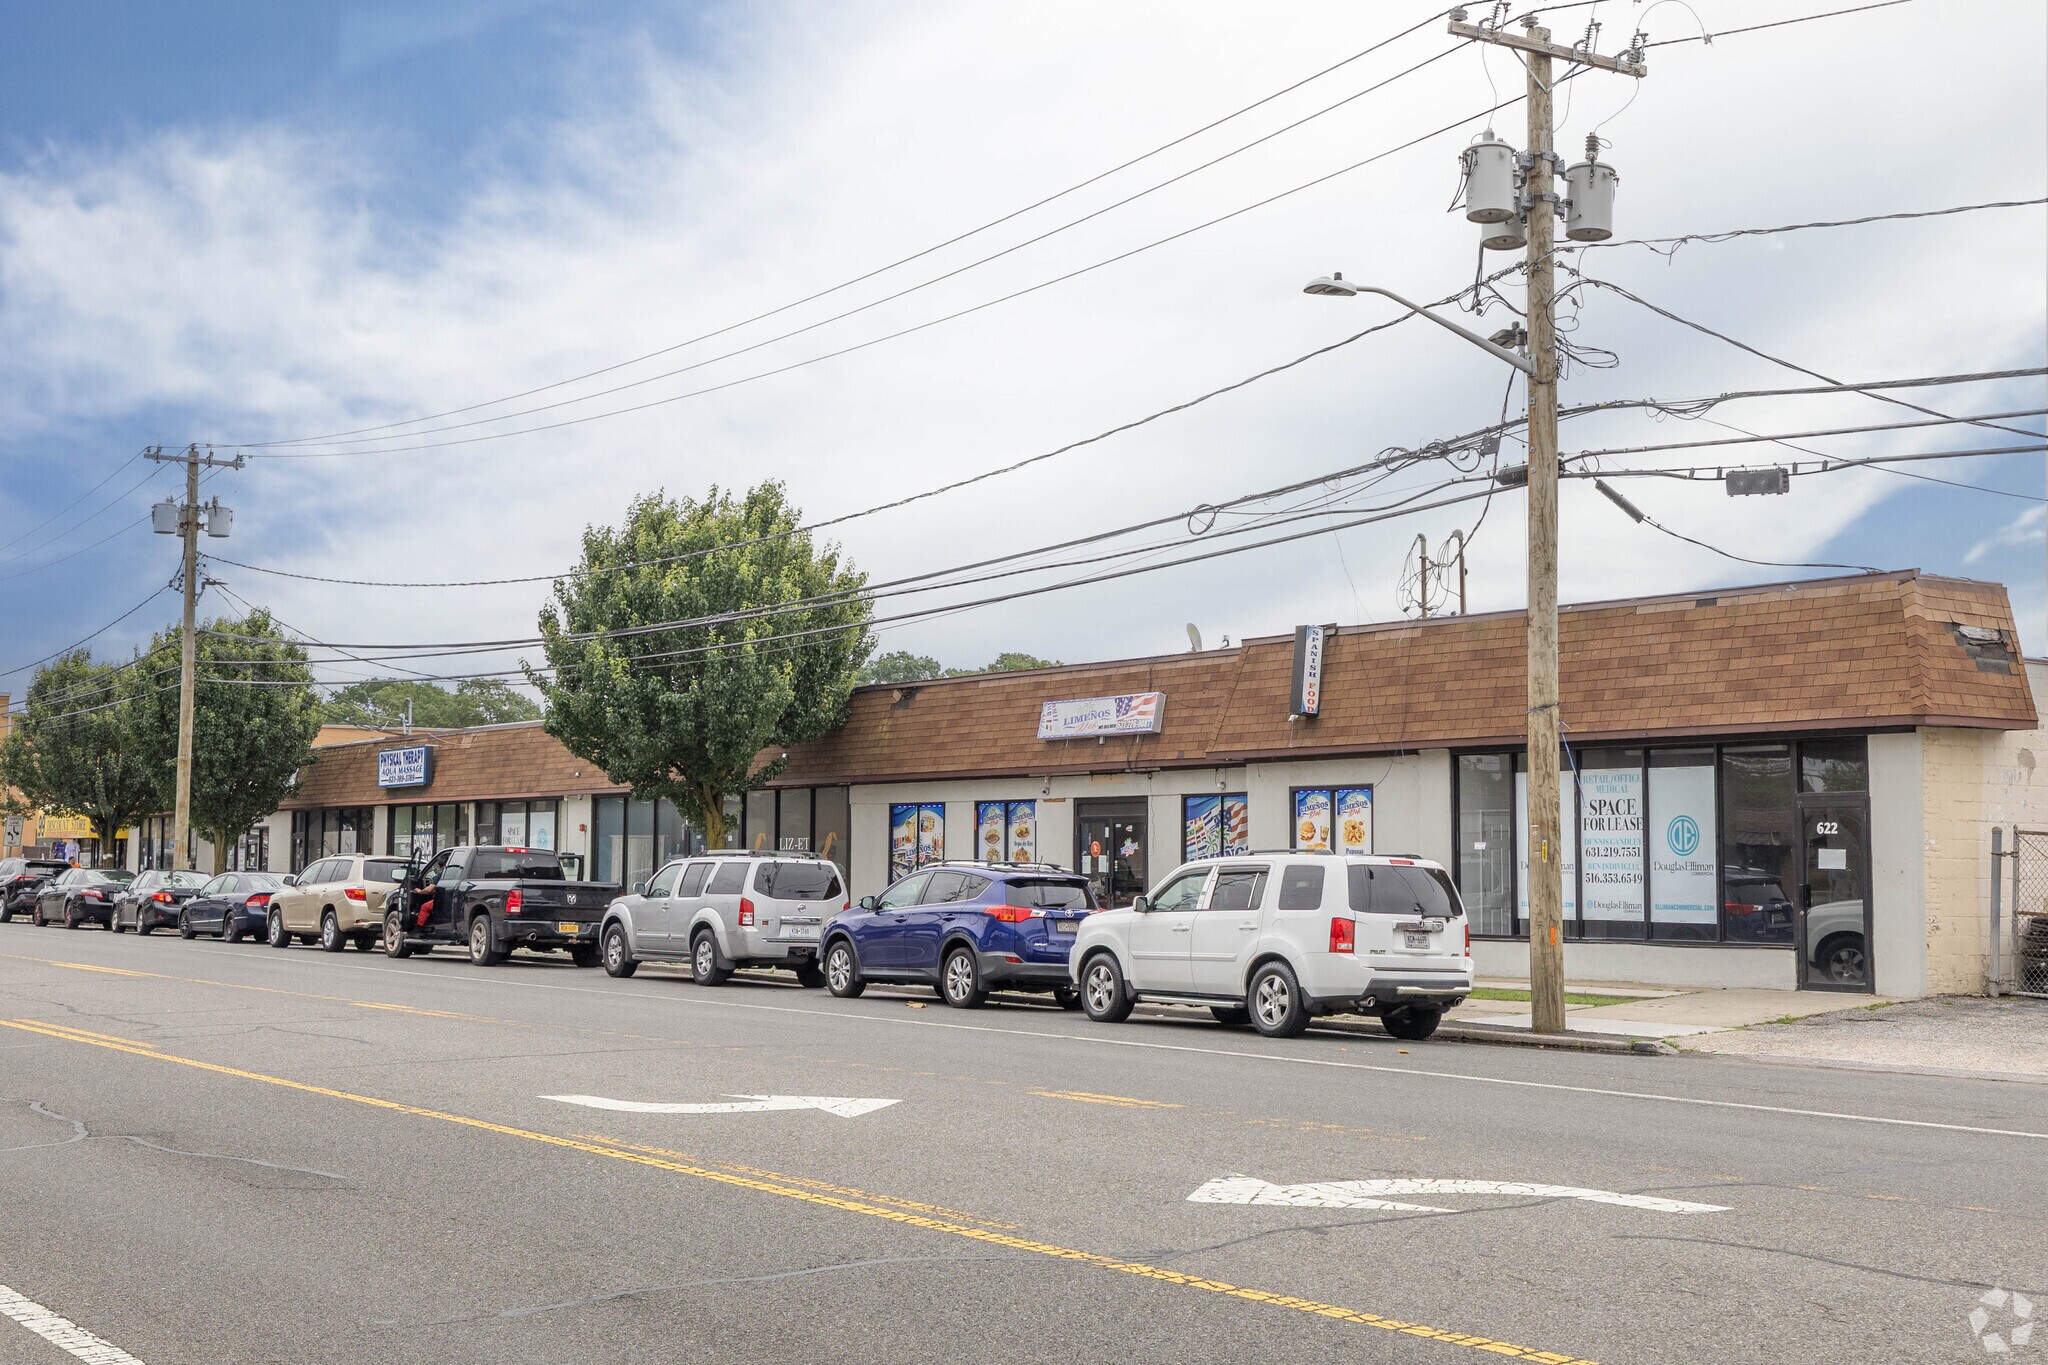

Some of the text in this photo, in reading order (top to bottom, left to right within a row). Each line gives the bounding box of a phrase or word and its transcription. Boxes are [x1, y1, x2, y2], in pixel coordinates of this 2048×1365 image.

[1307, 629, 1319, 713] SPANISH FOOD
[1063, 709, 1111, 726] LIMEÑOS
[381, 749, 424, 767] PHYSICAL THERAPY
[382, 764, 423, 777] AQUA MASSAGE
[1596, 784, 1629, 793] MEDICAL
[1300, 801, 1329, 813] LIMEÑOS
[1340, 800, 1369, 812] LIMEÑOS
[1589, 798, 1637, 816] SPACE
[47, 818, 86, 832] DISCOUNT STORE
[1583, 816, 1644, 831] FOR LEASE
[1816, 821, 1839, 835] 622
[507, 827, 520, 836] SPACE
[779, 837, 810, 850] LIZ-ET
[1584, 838, 1609, 846] DENNIS
[1345, 847, 1365, 855] Pupusas
[1585, 846, 1641, 858] 631.219.7551
[1587, 863, 1601, 871] BEN
[1585, 872, 1643, 884] 516.353.6549
